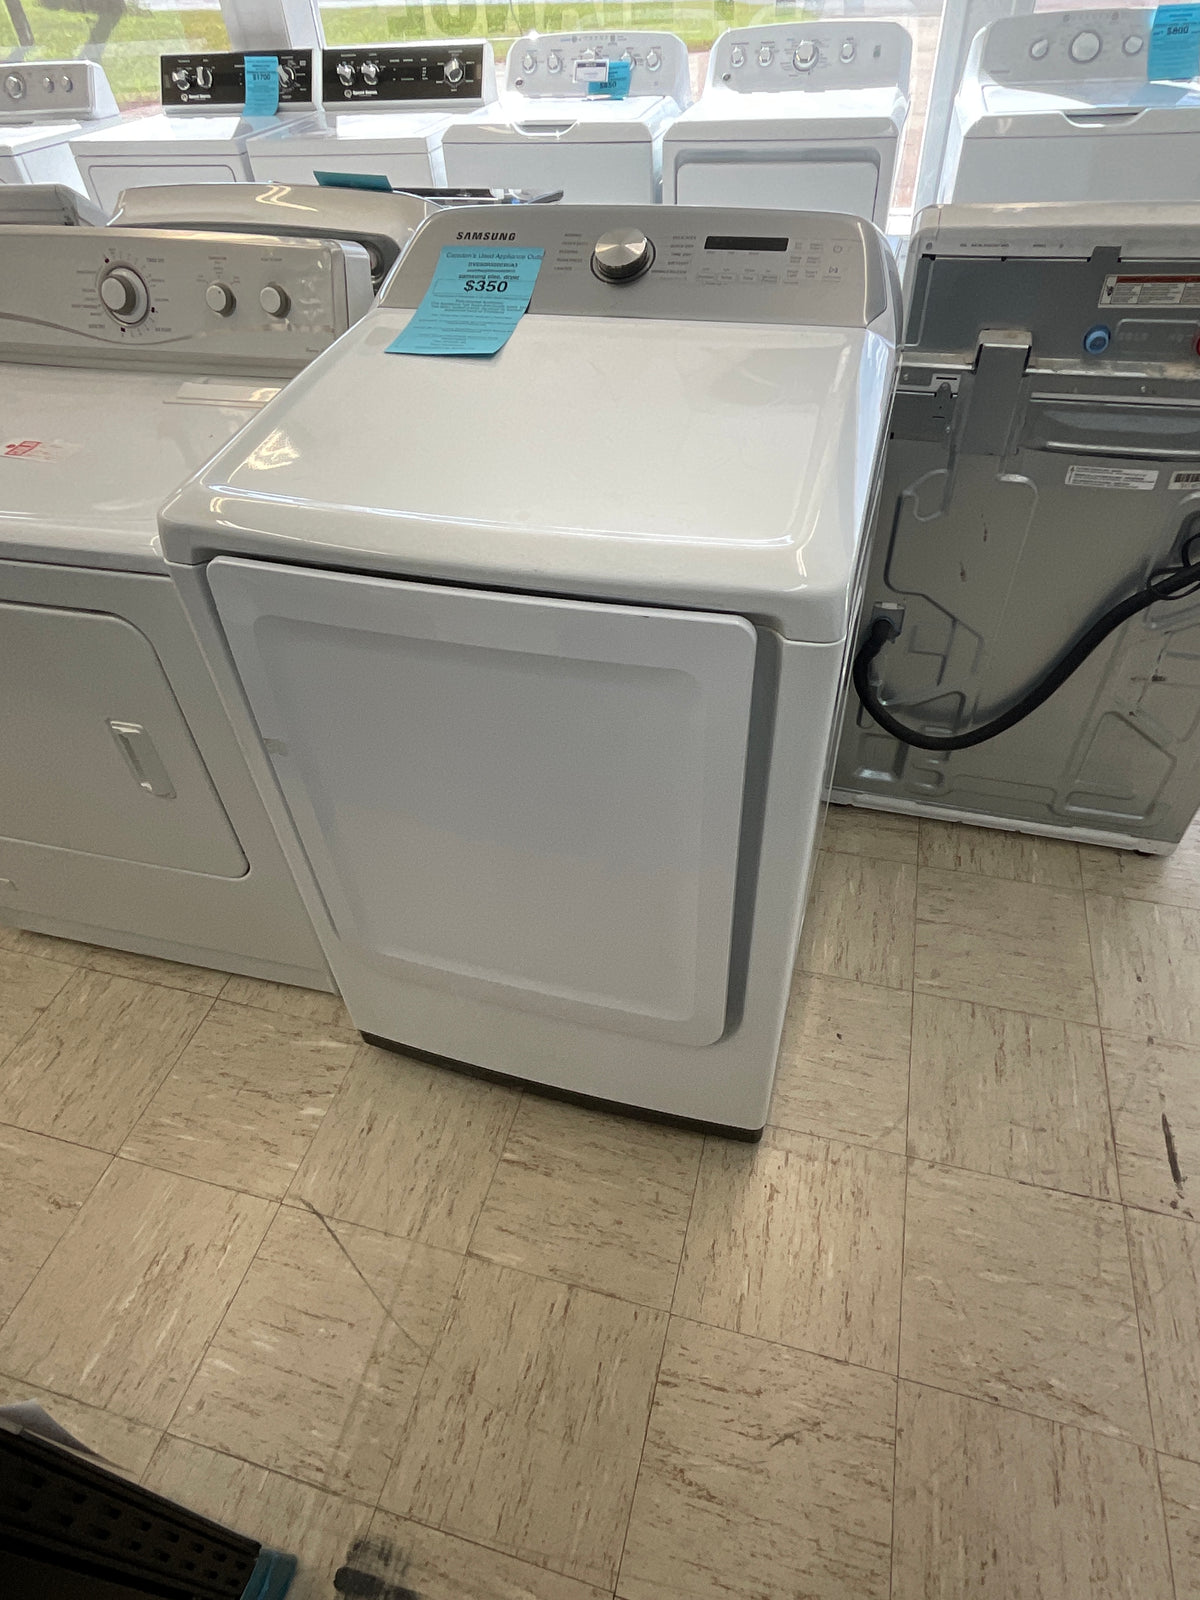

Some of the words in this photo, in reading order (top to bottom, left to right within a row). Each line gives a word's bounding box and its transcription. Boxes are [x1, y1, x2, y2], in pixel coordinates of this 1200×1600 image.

[456, 231, 516, 241] SAMSUNG
[495, 253, 526, 261] Appliance
[463, 279, 508, 293] $350
